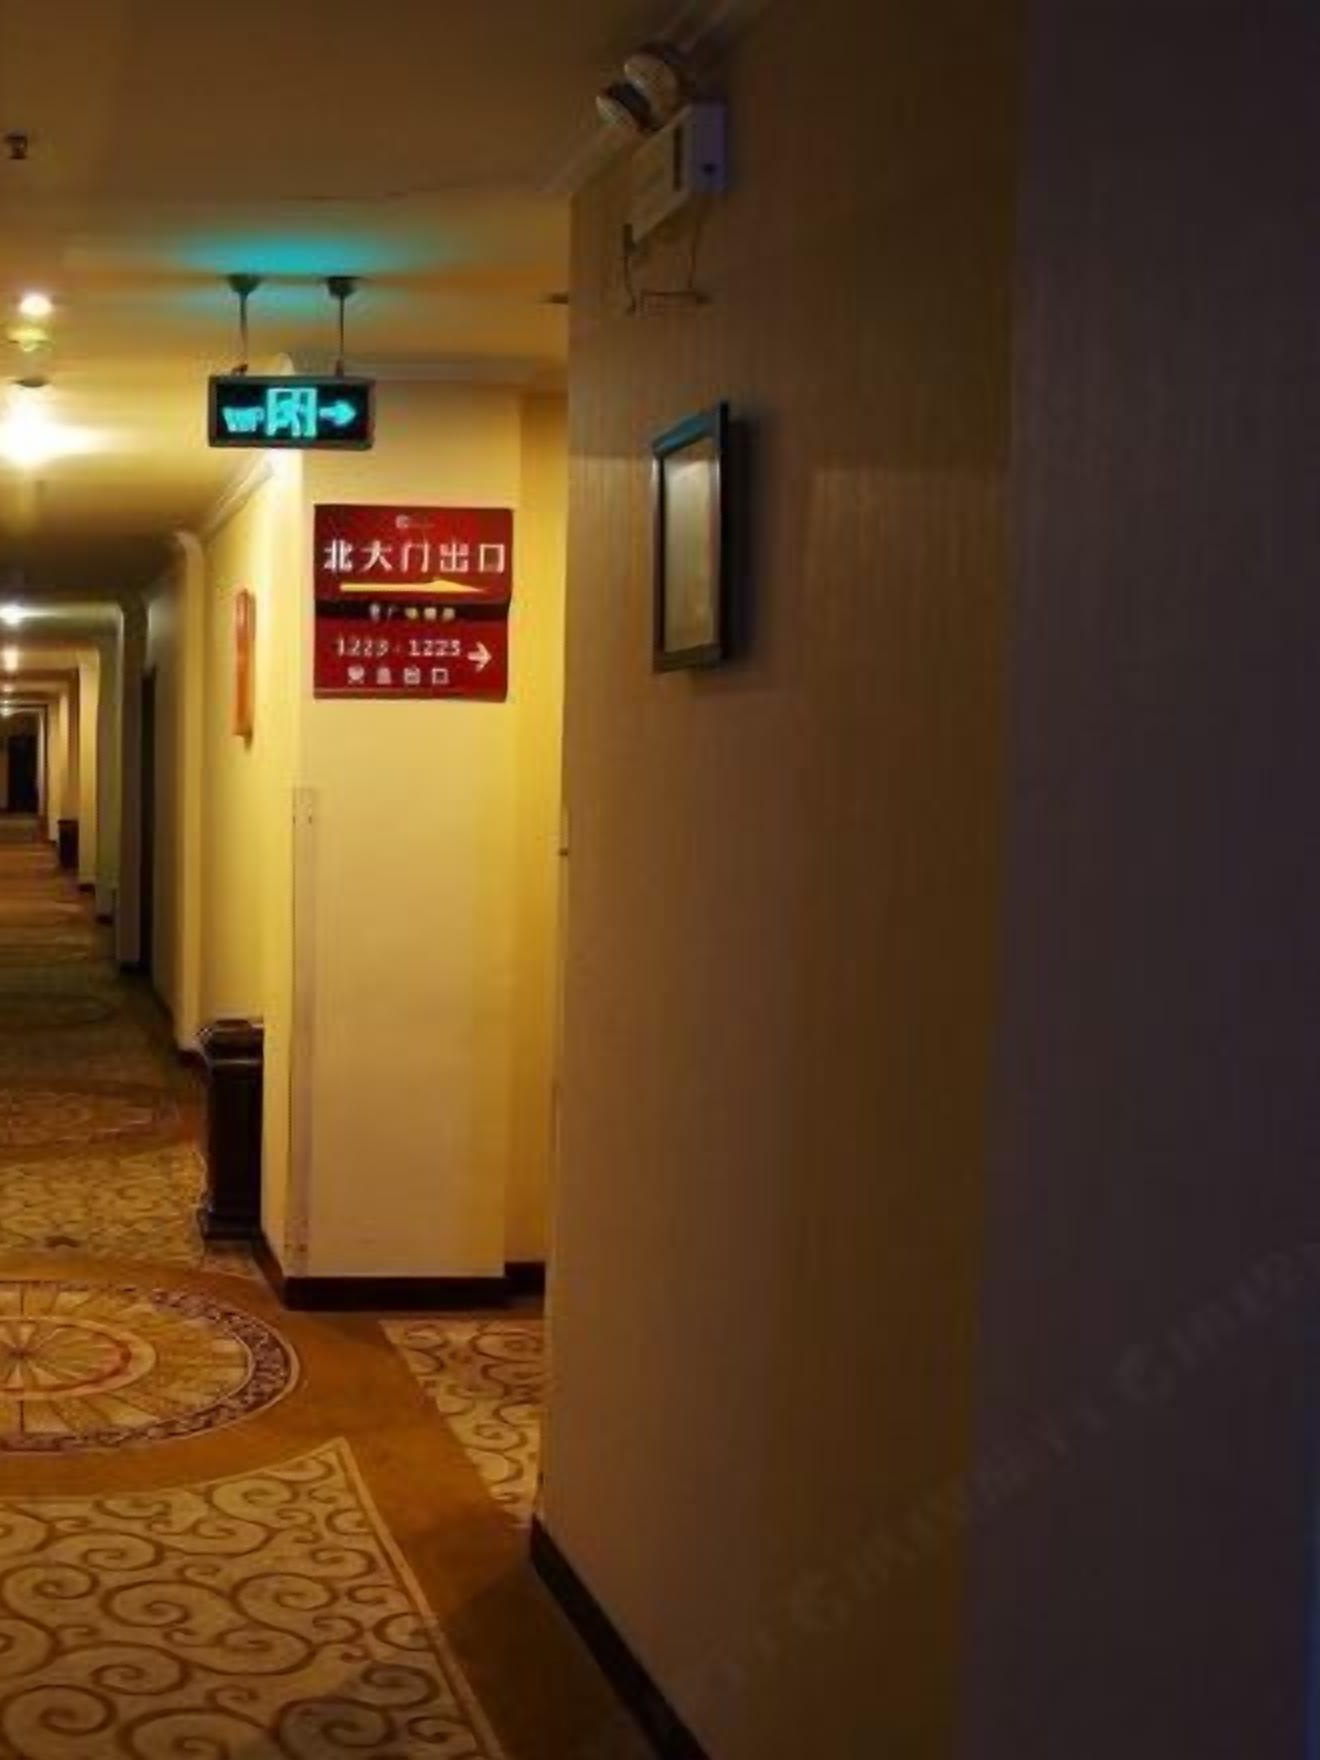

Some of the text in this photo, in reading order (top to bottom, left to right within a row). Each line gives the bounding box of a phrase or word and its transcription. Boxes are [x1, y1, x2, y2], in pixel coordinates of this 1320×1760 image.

[323, 539, 505, 573] 北大门出口
